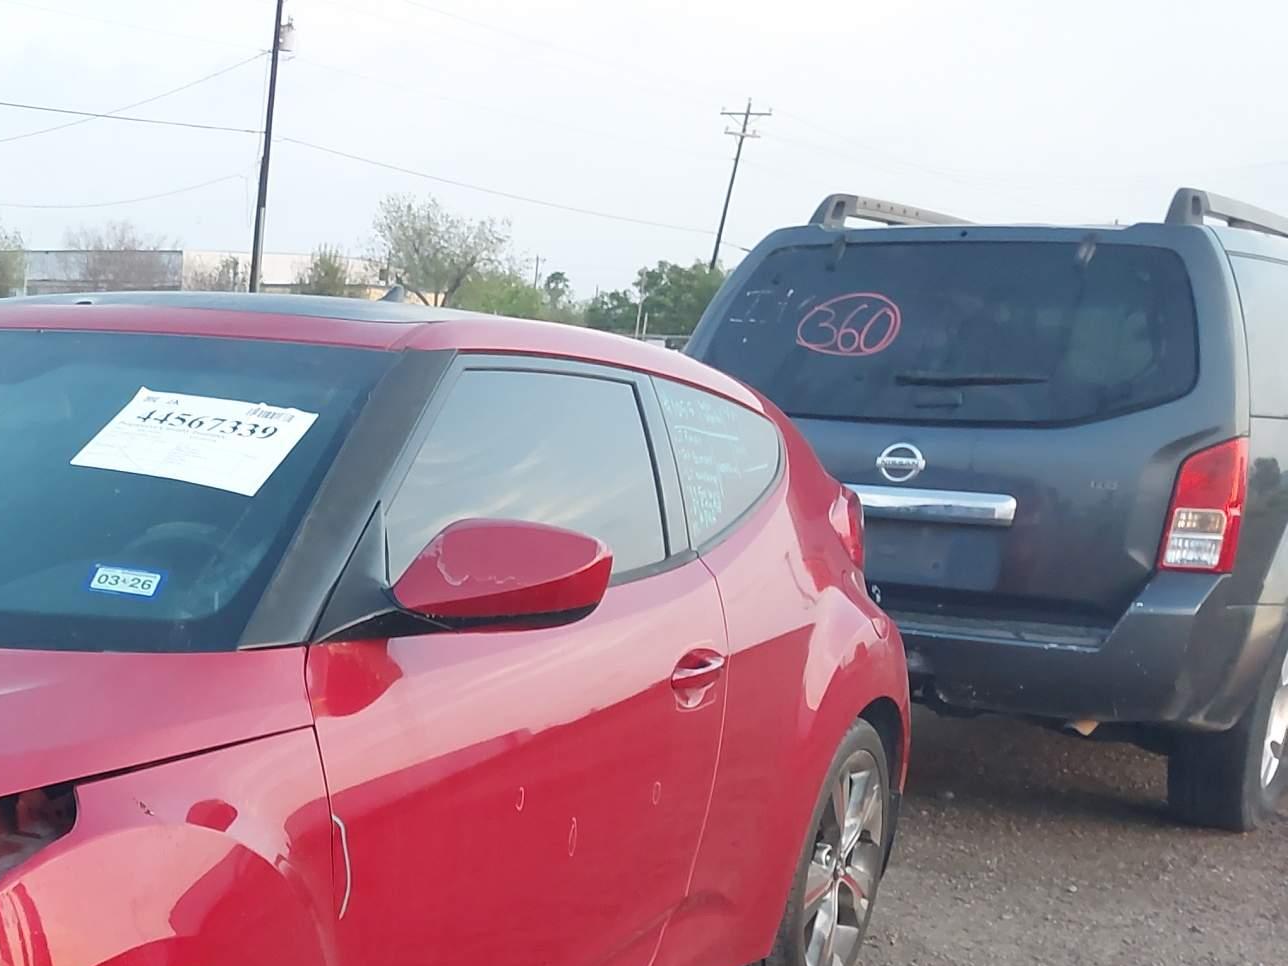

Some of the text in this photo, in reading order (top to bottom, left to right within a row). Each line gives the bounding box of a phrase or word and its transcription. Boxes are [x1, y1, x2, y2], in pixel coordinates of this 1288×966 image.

[810, 303, 896, 353] 360
[136, 409, 279, 439] 44567339
[880, 457, 920, 469] NISSAN
[97, 573, 153, 591] 03 26
